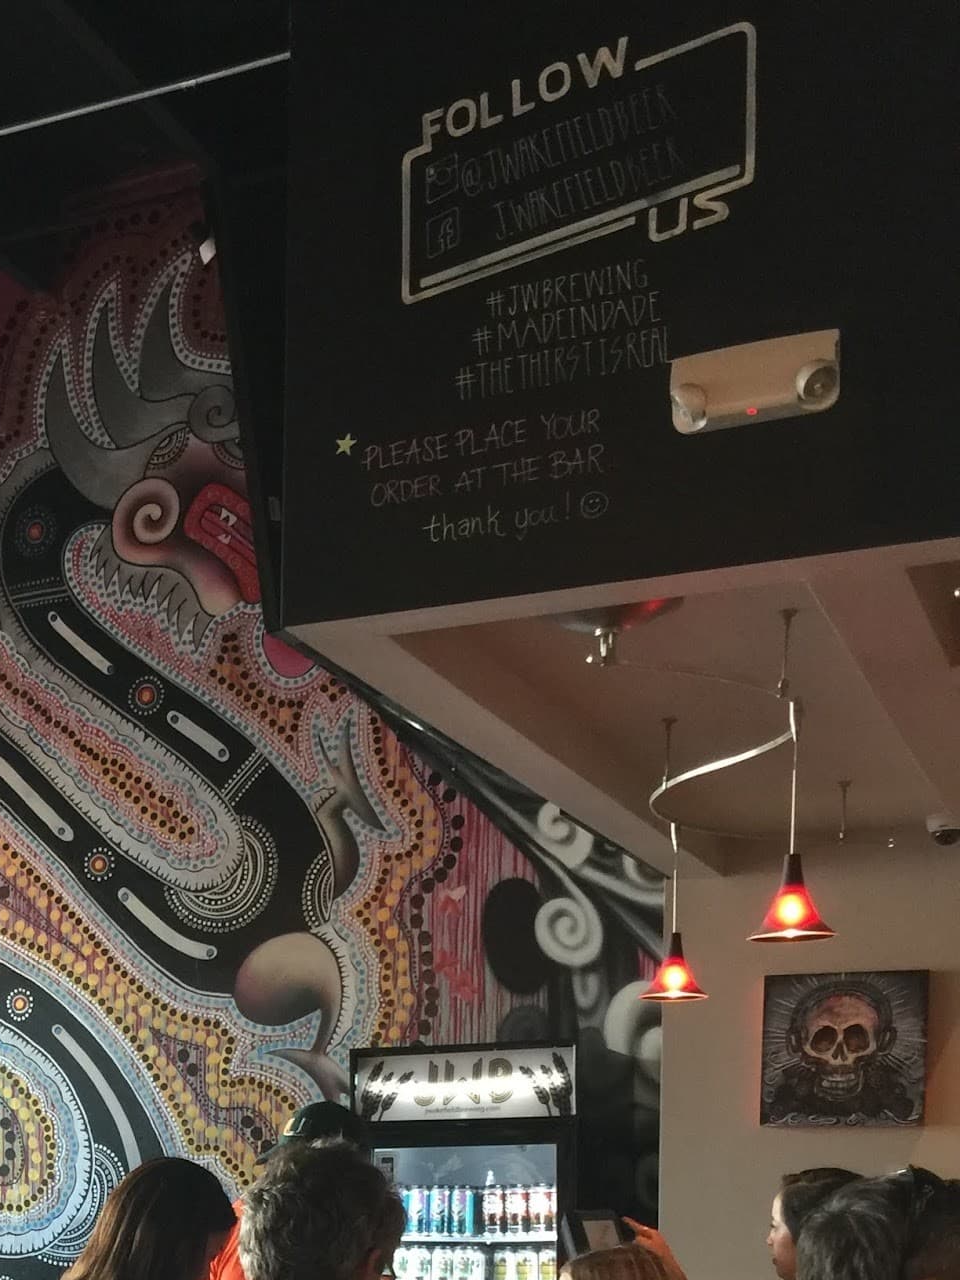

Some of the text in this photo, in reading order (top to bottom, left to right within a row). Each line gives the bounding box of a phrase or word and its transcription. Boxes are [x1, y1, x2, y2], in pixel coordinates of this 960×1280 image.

[421, 36, 630, 150] FOLLOW
[648, 194, 730, 243] US
[485, 259, 648, 319] #JWBREWING
[471, 291, 664, 357] #MADEINDADE
[455, 325, 672, 401] #THETHIRSTISREAL
[361, 408, 602, 471] PLEASE PLACE YOUR
[370, 443, 606, 508] ORDER AT THE BAR
[422, 503, 506, 544] thank
